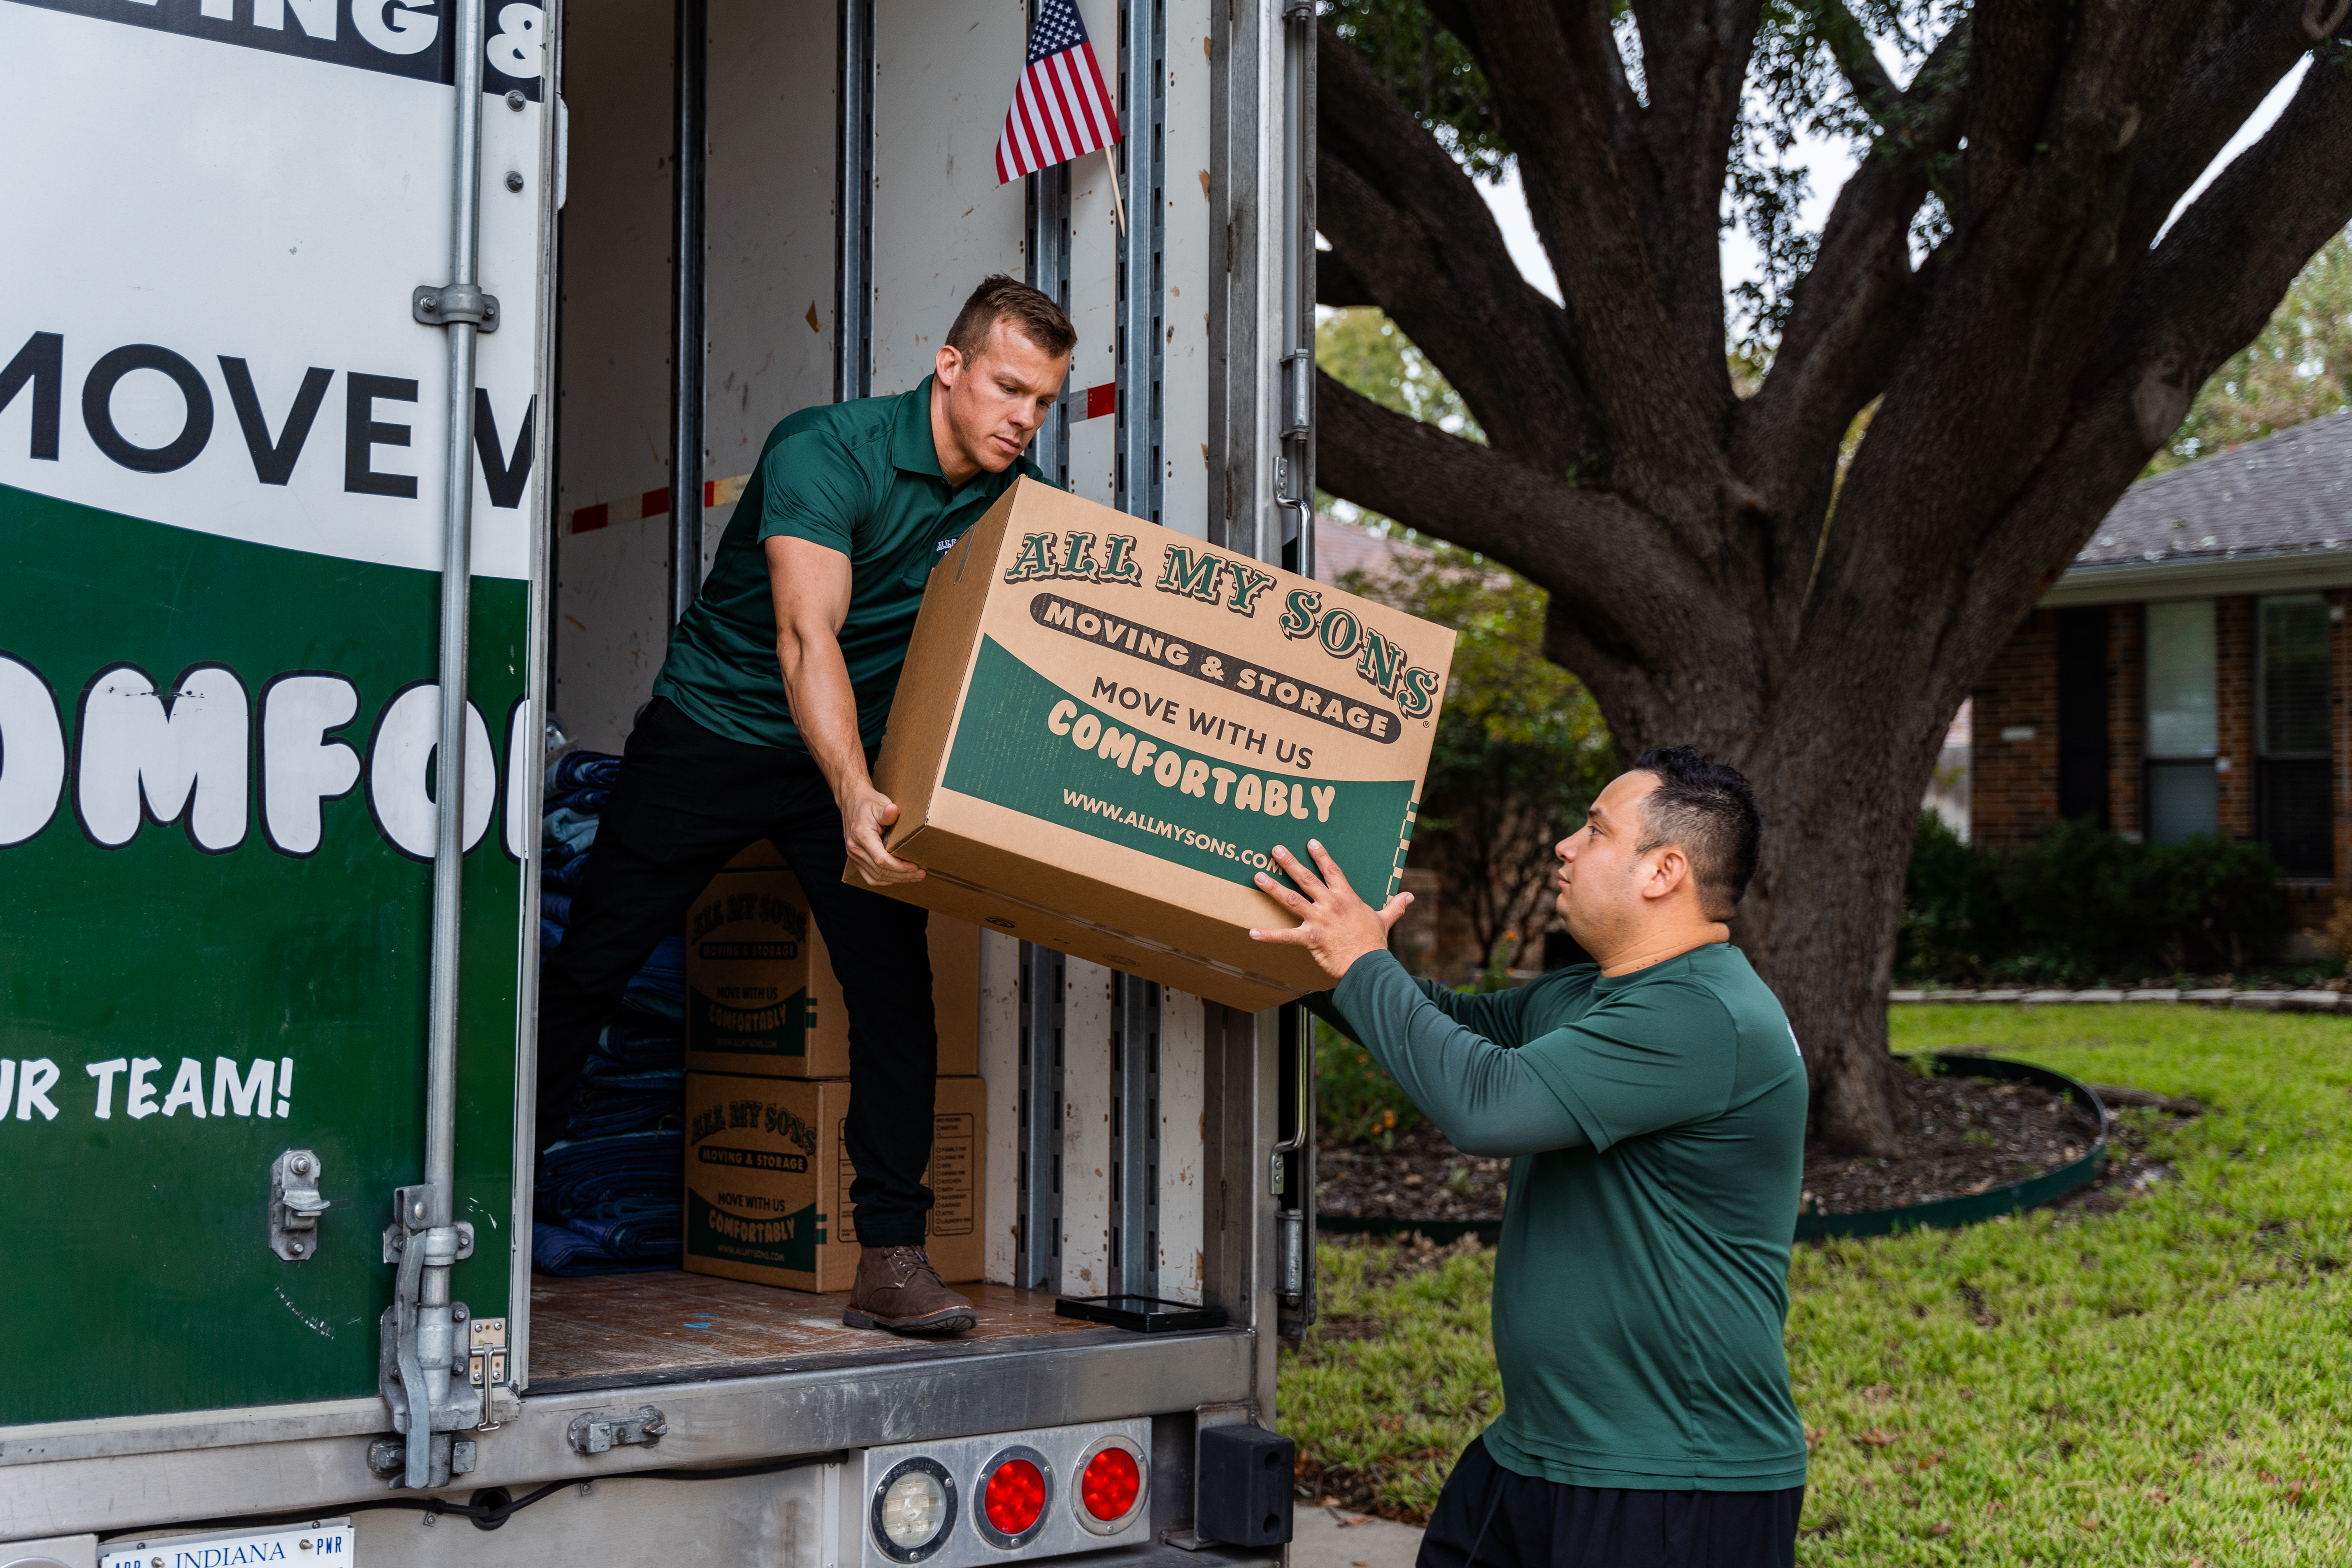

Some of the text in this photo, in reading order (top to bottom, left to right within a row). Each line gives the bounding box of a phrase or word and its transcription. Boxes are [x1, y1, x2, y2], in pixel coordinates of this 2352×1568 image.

[1004, 531, 1142, 588] ALL
[1156, 544, 1276, 618] MY
[1279, 588, 1439, 720] SONS
[1044, 600, 1389, 738] MOVING & STORAGE
[1092, 676, 1313, 770] MOVE WITH US
[1048, 699, 1336, 823] COMFORTABLY
[1063, 788, 1283, 876] WWW.ALLMYSONS.COM
[703, 945, 795, 957] MOVING & STORAGE
[717, 987, 778, 1000] MOVE WITH US
[709, 1003, 786, 1033] COMFORTABLY
[86, 1057, 293, 1120] TEAM!
[690, 1100, 817, 1157] ALL MY SONS
[703, 1148, 803, 1171] MOVING & STORAGE
[718, 1192, 785, 1212] MOVE WITH US
[708, 1209, 795, 1244] COMFORTABLY
[717, 1243, 785, 1262] WWW.ALLMYSONS.COM
[176, 1536, 342, 1568] INDIANA PWR
